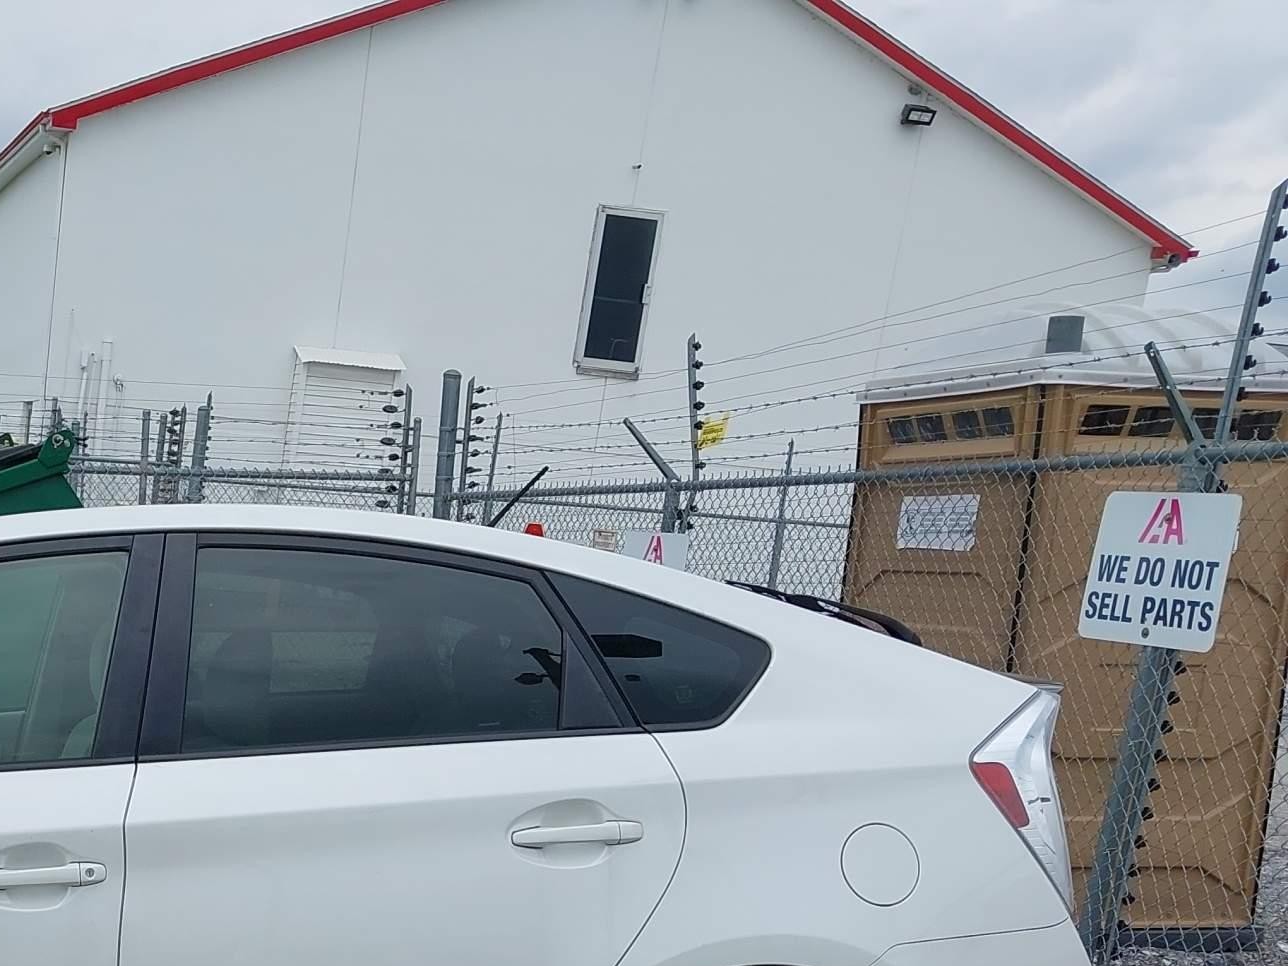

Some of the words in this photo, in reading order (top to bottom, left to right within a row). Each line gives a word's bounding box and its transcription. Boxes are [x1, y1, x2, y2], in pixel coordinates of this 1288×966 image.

[1097, 554, 1131, 584] WE
[1134, 557, 1166, 587] DO
[1170, 559, 1220, 591] NOT
[1084, 591, 1132, 623] SELL
[1140, 596, 1215, 632] PARTS
